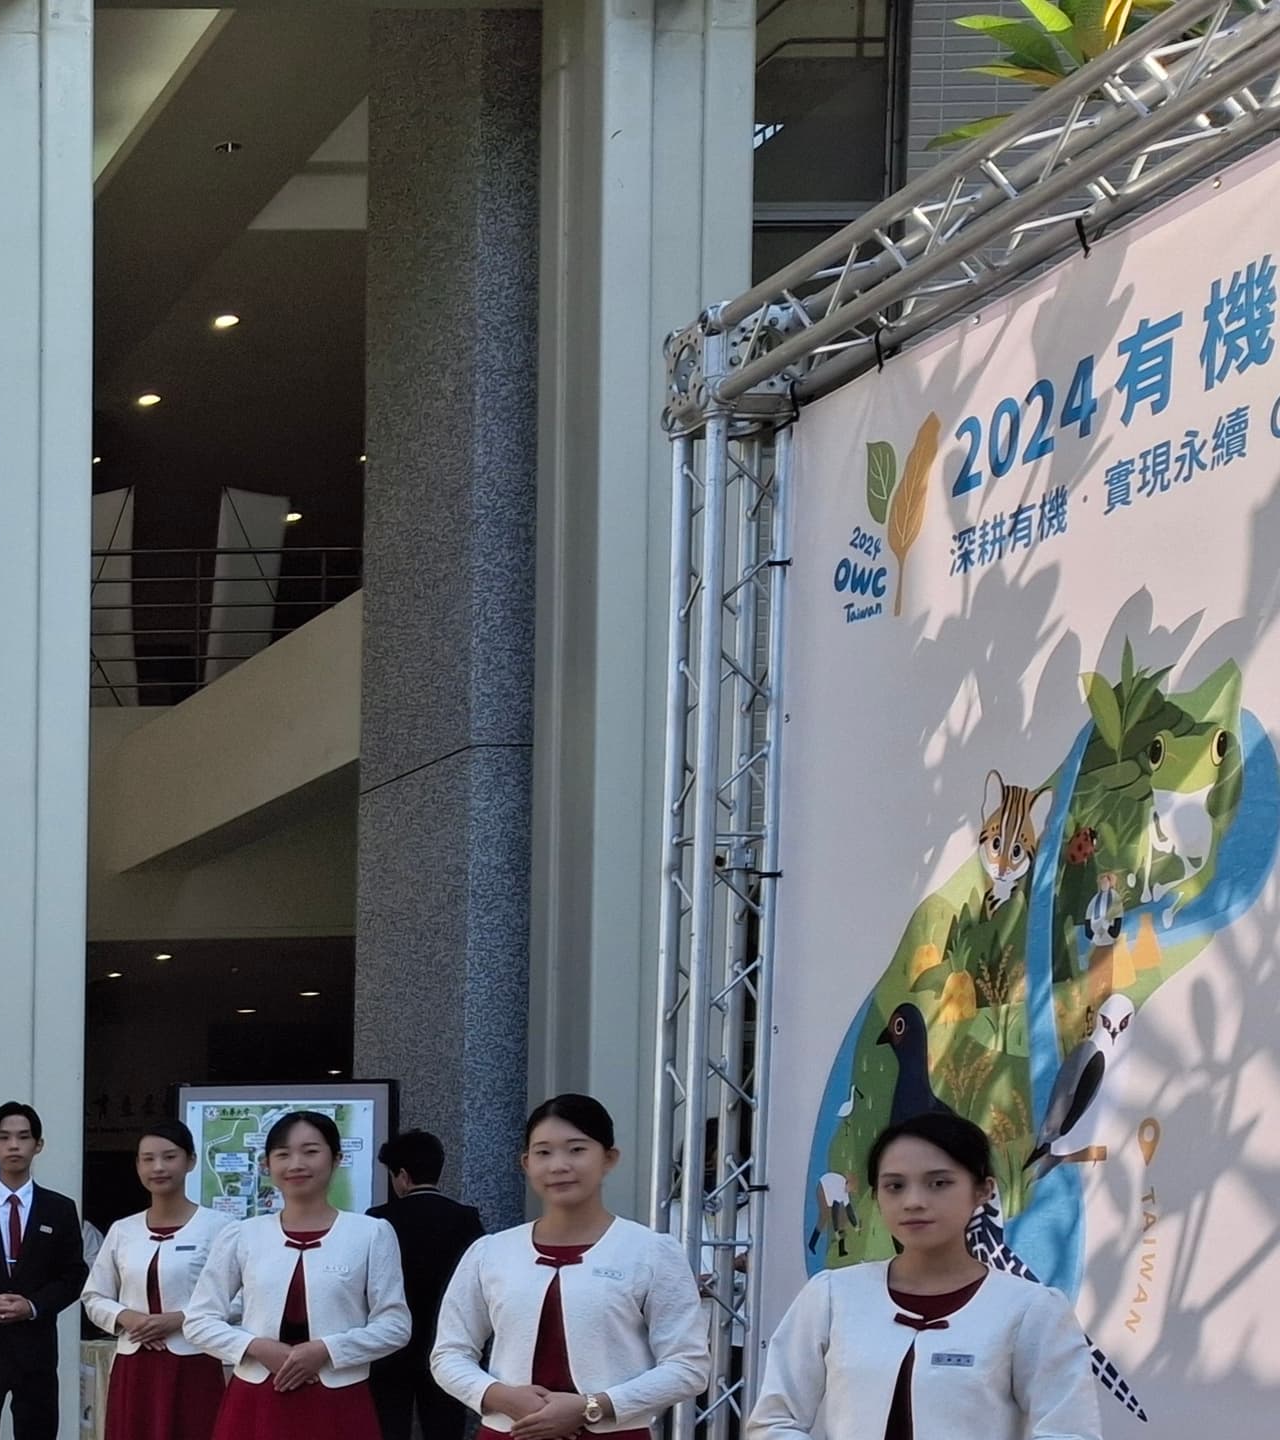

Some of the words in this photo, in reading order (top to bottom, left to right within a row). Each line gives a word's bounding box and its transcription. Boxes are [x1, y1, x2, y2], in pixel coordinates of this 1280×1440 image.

[849, 526, 882, 561] 2024
[834, 557, 888, 598] OWC
[843, 602, 882, 624] Taiwan
[1124, 1185, 1158, 1334] TAIWAN
